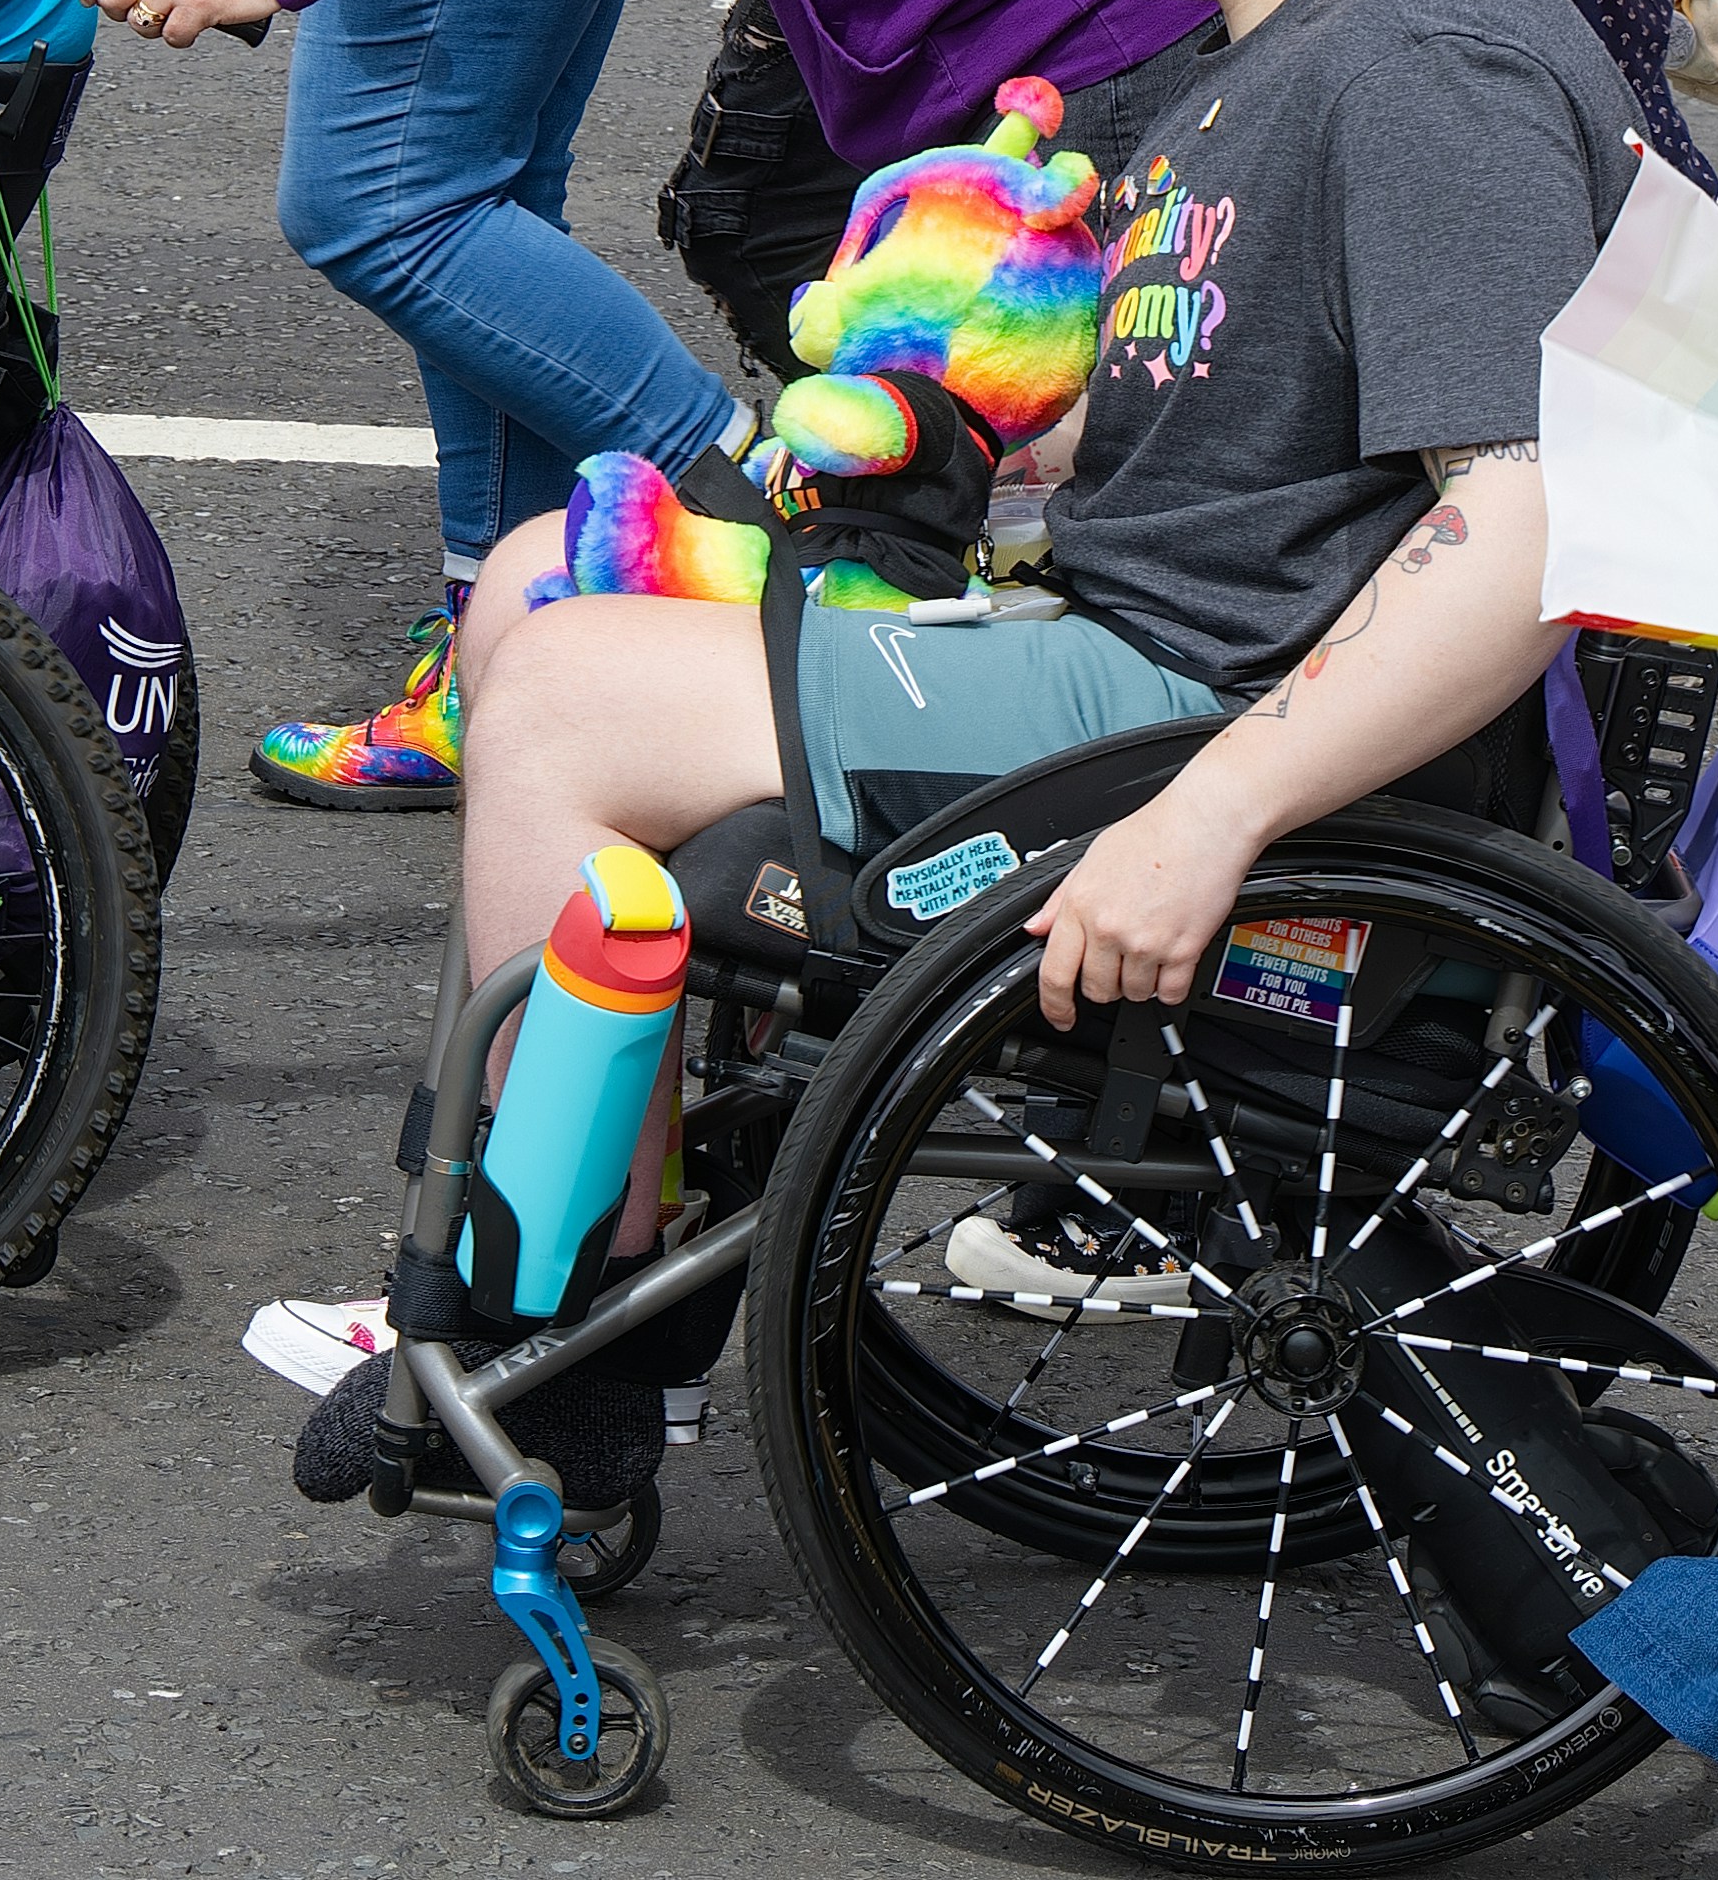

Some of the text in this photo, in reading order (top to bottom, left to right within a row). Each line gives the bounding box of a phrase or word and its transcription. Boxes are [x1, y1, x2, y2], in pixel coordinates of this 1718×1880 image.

[895, 840, 1002, 886] PHYSICALLY HERE
[895, 854, 1011, 901] MENTALLY AT HOME
[919, 872, 996, 913] WITH MY DOG
[1251, 934, 1338, 968] DOES NOT MEAN
[1266, 920, 1333, 948] FOR OTHERS
[1249, 952, 1329, 983] FEWER RIGHTS
[1259, 972, 1307, 997] FOR YOU.
[1245, 986, 1312, 1015] IT'S NOT PIE.
[1027, 1780, 1277, 1862] TRAILBLAZER
